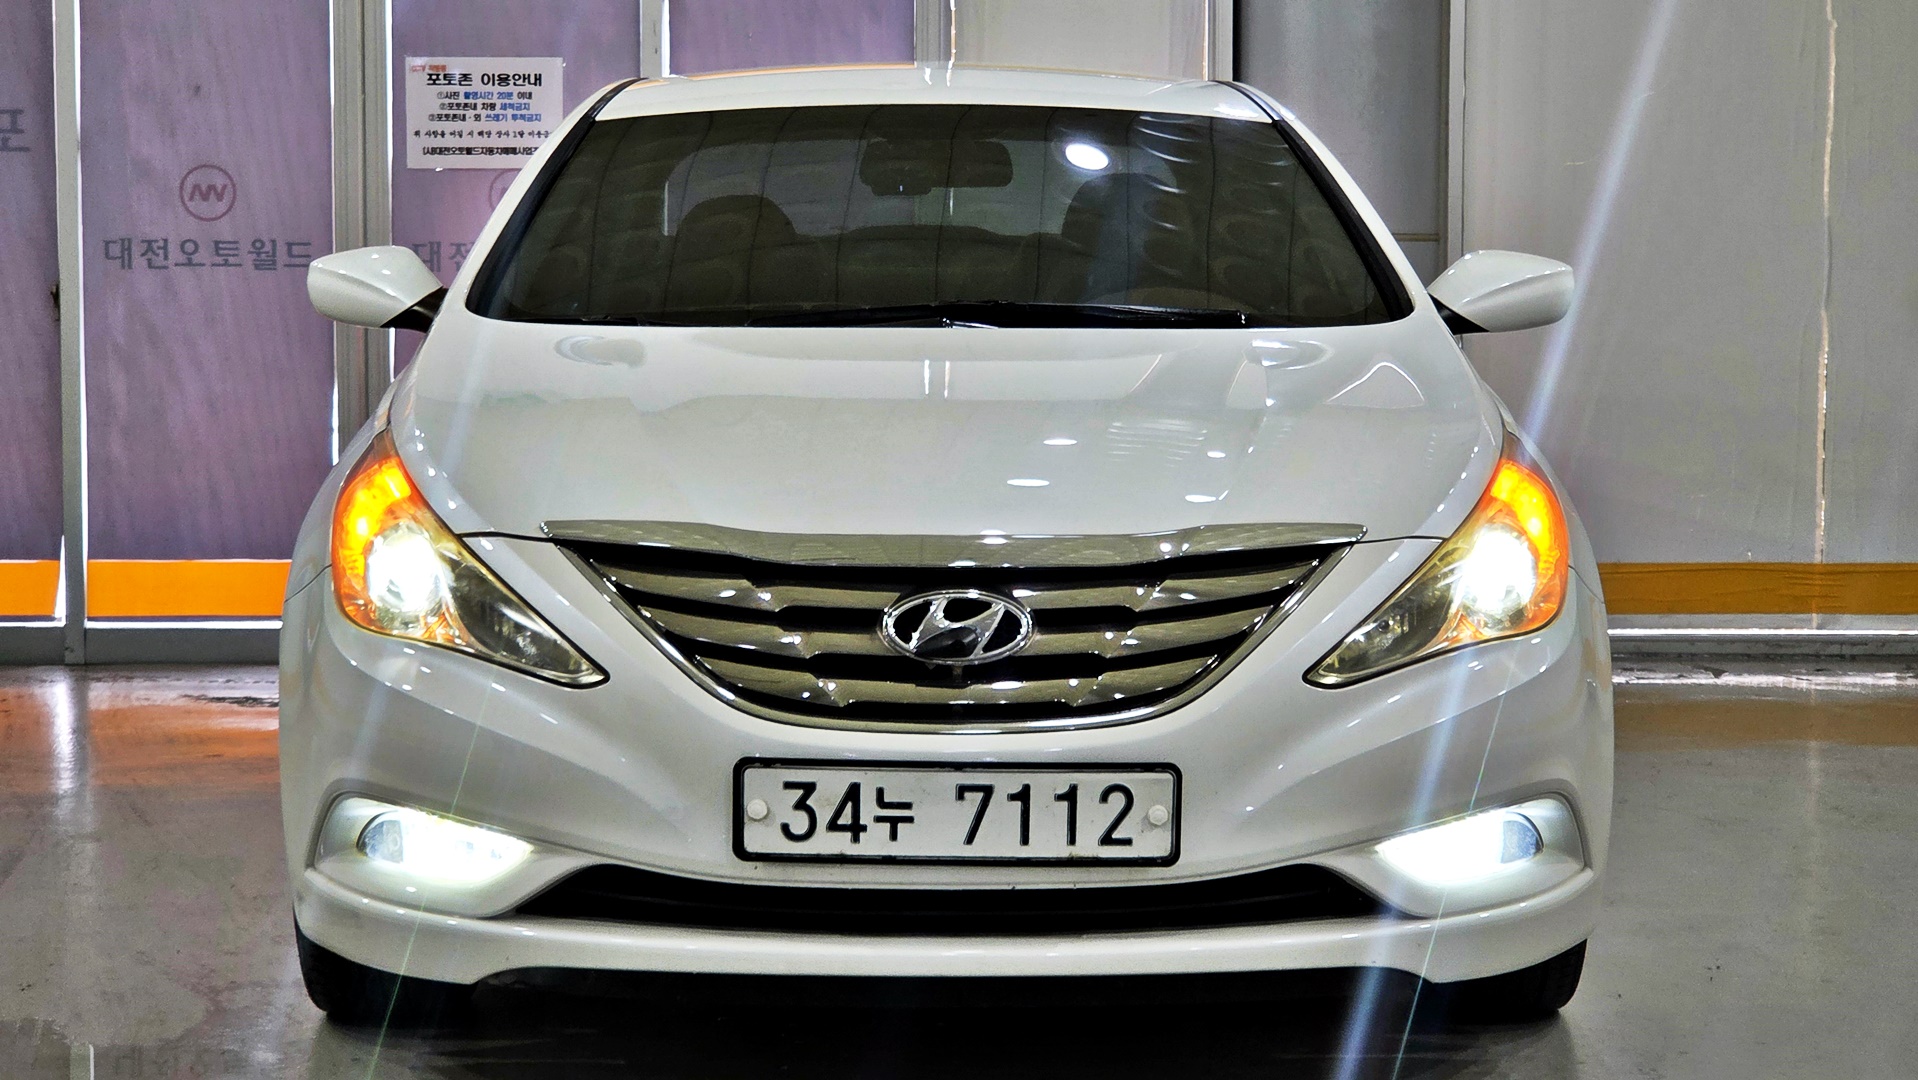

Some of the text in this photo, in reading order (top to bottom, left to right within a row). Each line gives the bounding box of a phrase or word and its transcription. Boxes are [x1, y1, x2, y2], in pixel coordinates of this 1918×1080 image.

[426, 73, 542, 87] 포토존 이용안내
[463, 92, 493, 100] 촬영시간
[497, 92, 513, 100] 20분
[517, 92, 532, 100] 이내
[481, 103, 496, 111] 차량
[500, 103, 530, 111] 세척금지
[474, 114, 481, 122] 외
[485, 114, 507, 122] 쓰레기
[511, 114, 541, 122] 투척금지
[424, 130, 445, 138] 사항을
[449, 130, 463, 138] 어길
[467, 130, 474, 138] 시
[477, 130, 492, 138] 해당
[495, 130, 510, 138] 상사
[103, 237, 312, 270] 대전오토월드
[780, 780, 1135, 847] 34누 7112
